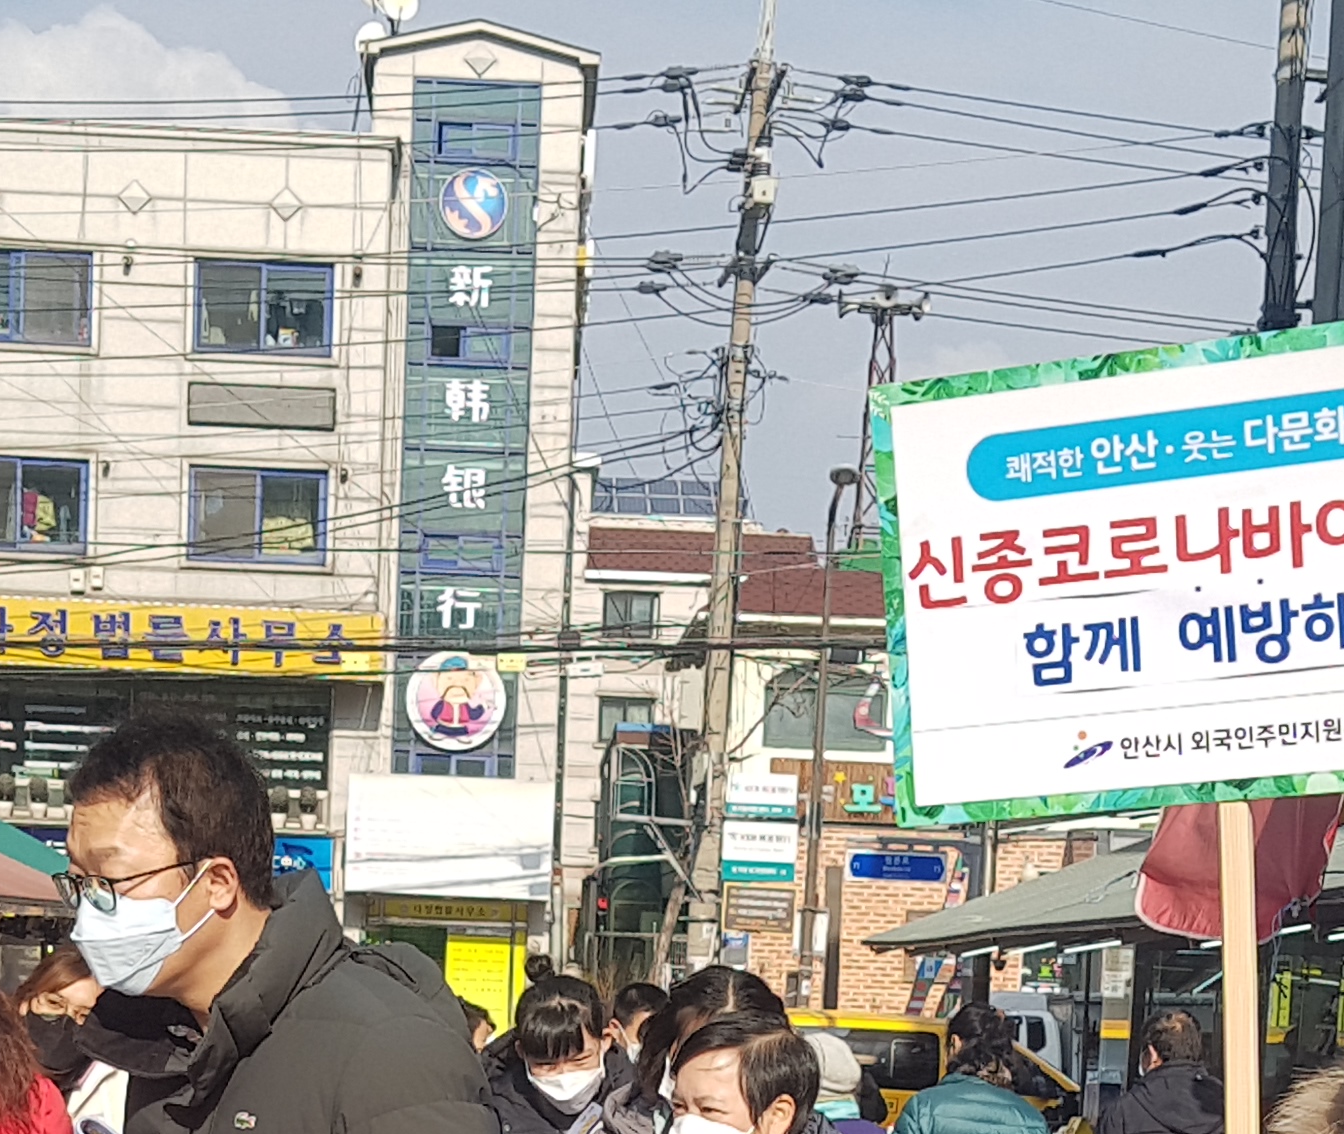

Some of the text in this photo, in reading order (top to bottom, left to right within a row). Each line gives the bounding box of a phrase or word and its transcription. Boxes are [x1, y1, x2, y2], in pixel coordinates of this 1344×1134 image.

[1005, 447, 1083, 485] 쾌적한
[1089, 431, 1159, 475] 안산
[1182, 431, 1235, 465] 웃는
[1022, 615, 1143, 689] 함께
[1120, 732, 1186, 762] 안산시
